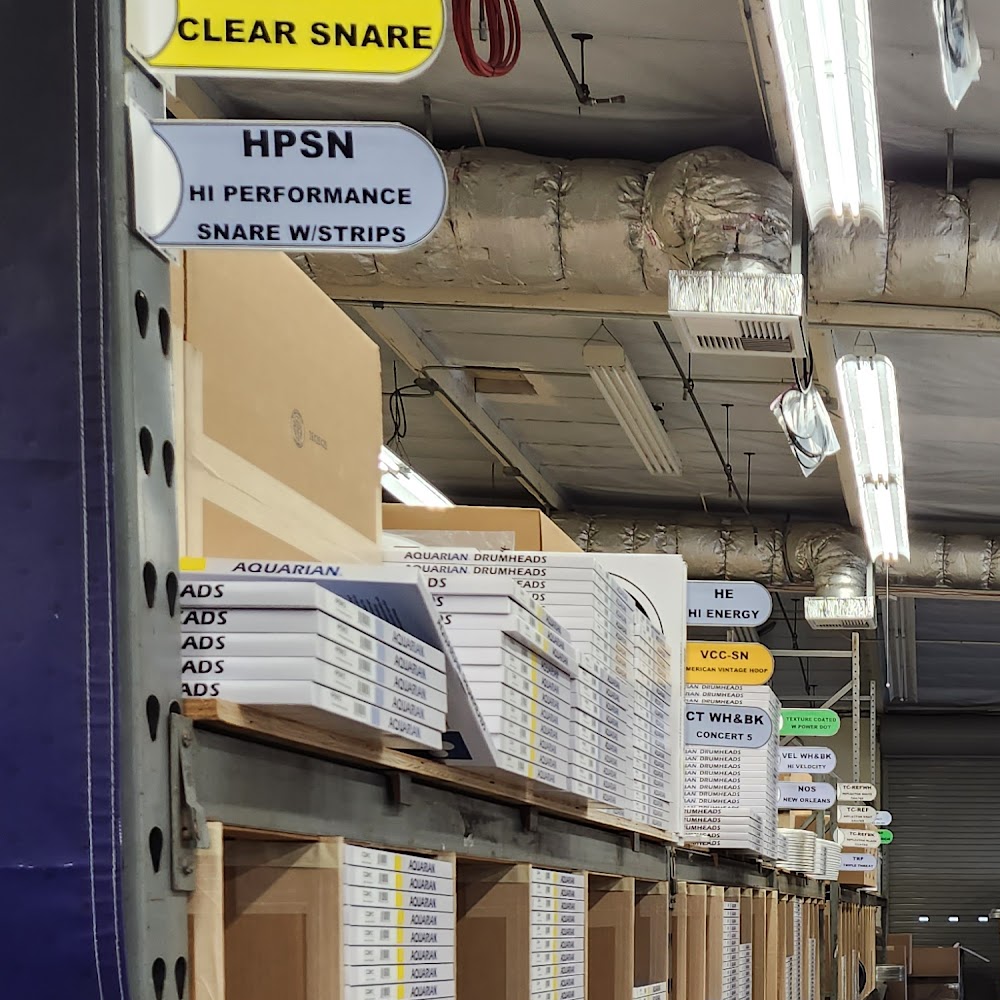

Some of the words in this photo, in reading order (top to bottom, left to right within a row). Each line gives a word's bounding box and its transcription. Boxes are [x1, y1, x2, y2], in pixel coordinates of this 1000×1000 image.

[177, 17, 297, 45] CLEAR
[311, 22, 433, 50] SNARE
[242, 129, 354, 159] HPSN
[189, 185, 214, 202] HI
[224, 186, 412, 206] PERFORMANCE
[197, 223, 280, 242] SNARE
[289, 225, 406, 243] W/STRIPS
[404, 552, 468, 561] AQUARIAN
[474, 554, 548, 563] DRUMHEADS
[232, 562, 341, 576] AQUARIAN
[406, 564, 468, 574] UARIAN
[474, 566, 547, 576] DRUMHEADS
[714, 589, 734, 598] HE
[688, 609, 701, 618] HI
[706, 610, 760, 618] ENERGY
[700, 650, 749, 660] VCC-SN
[686, 712, 704, 722] CT
[710, 712, 764, 725] WH&BK
[696, 731, 744, 740] CONCERT
